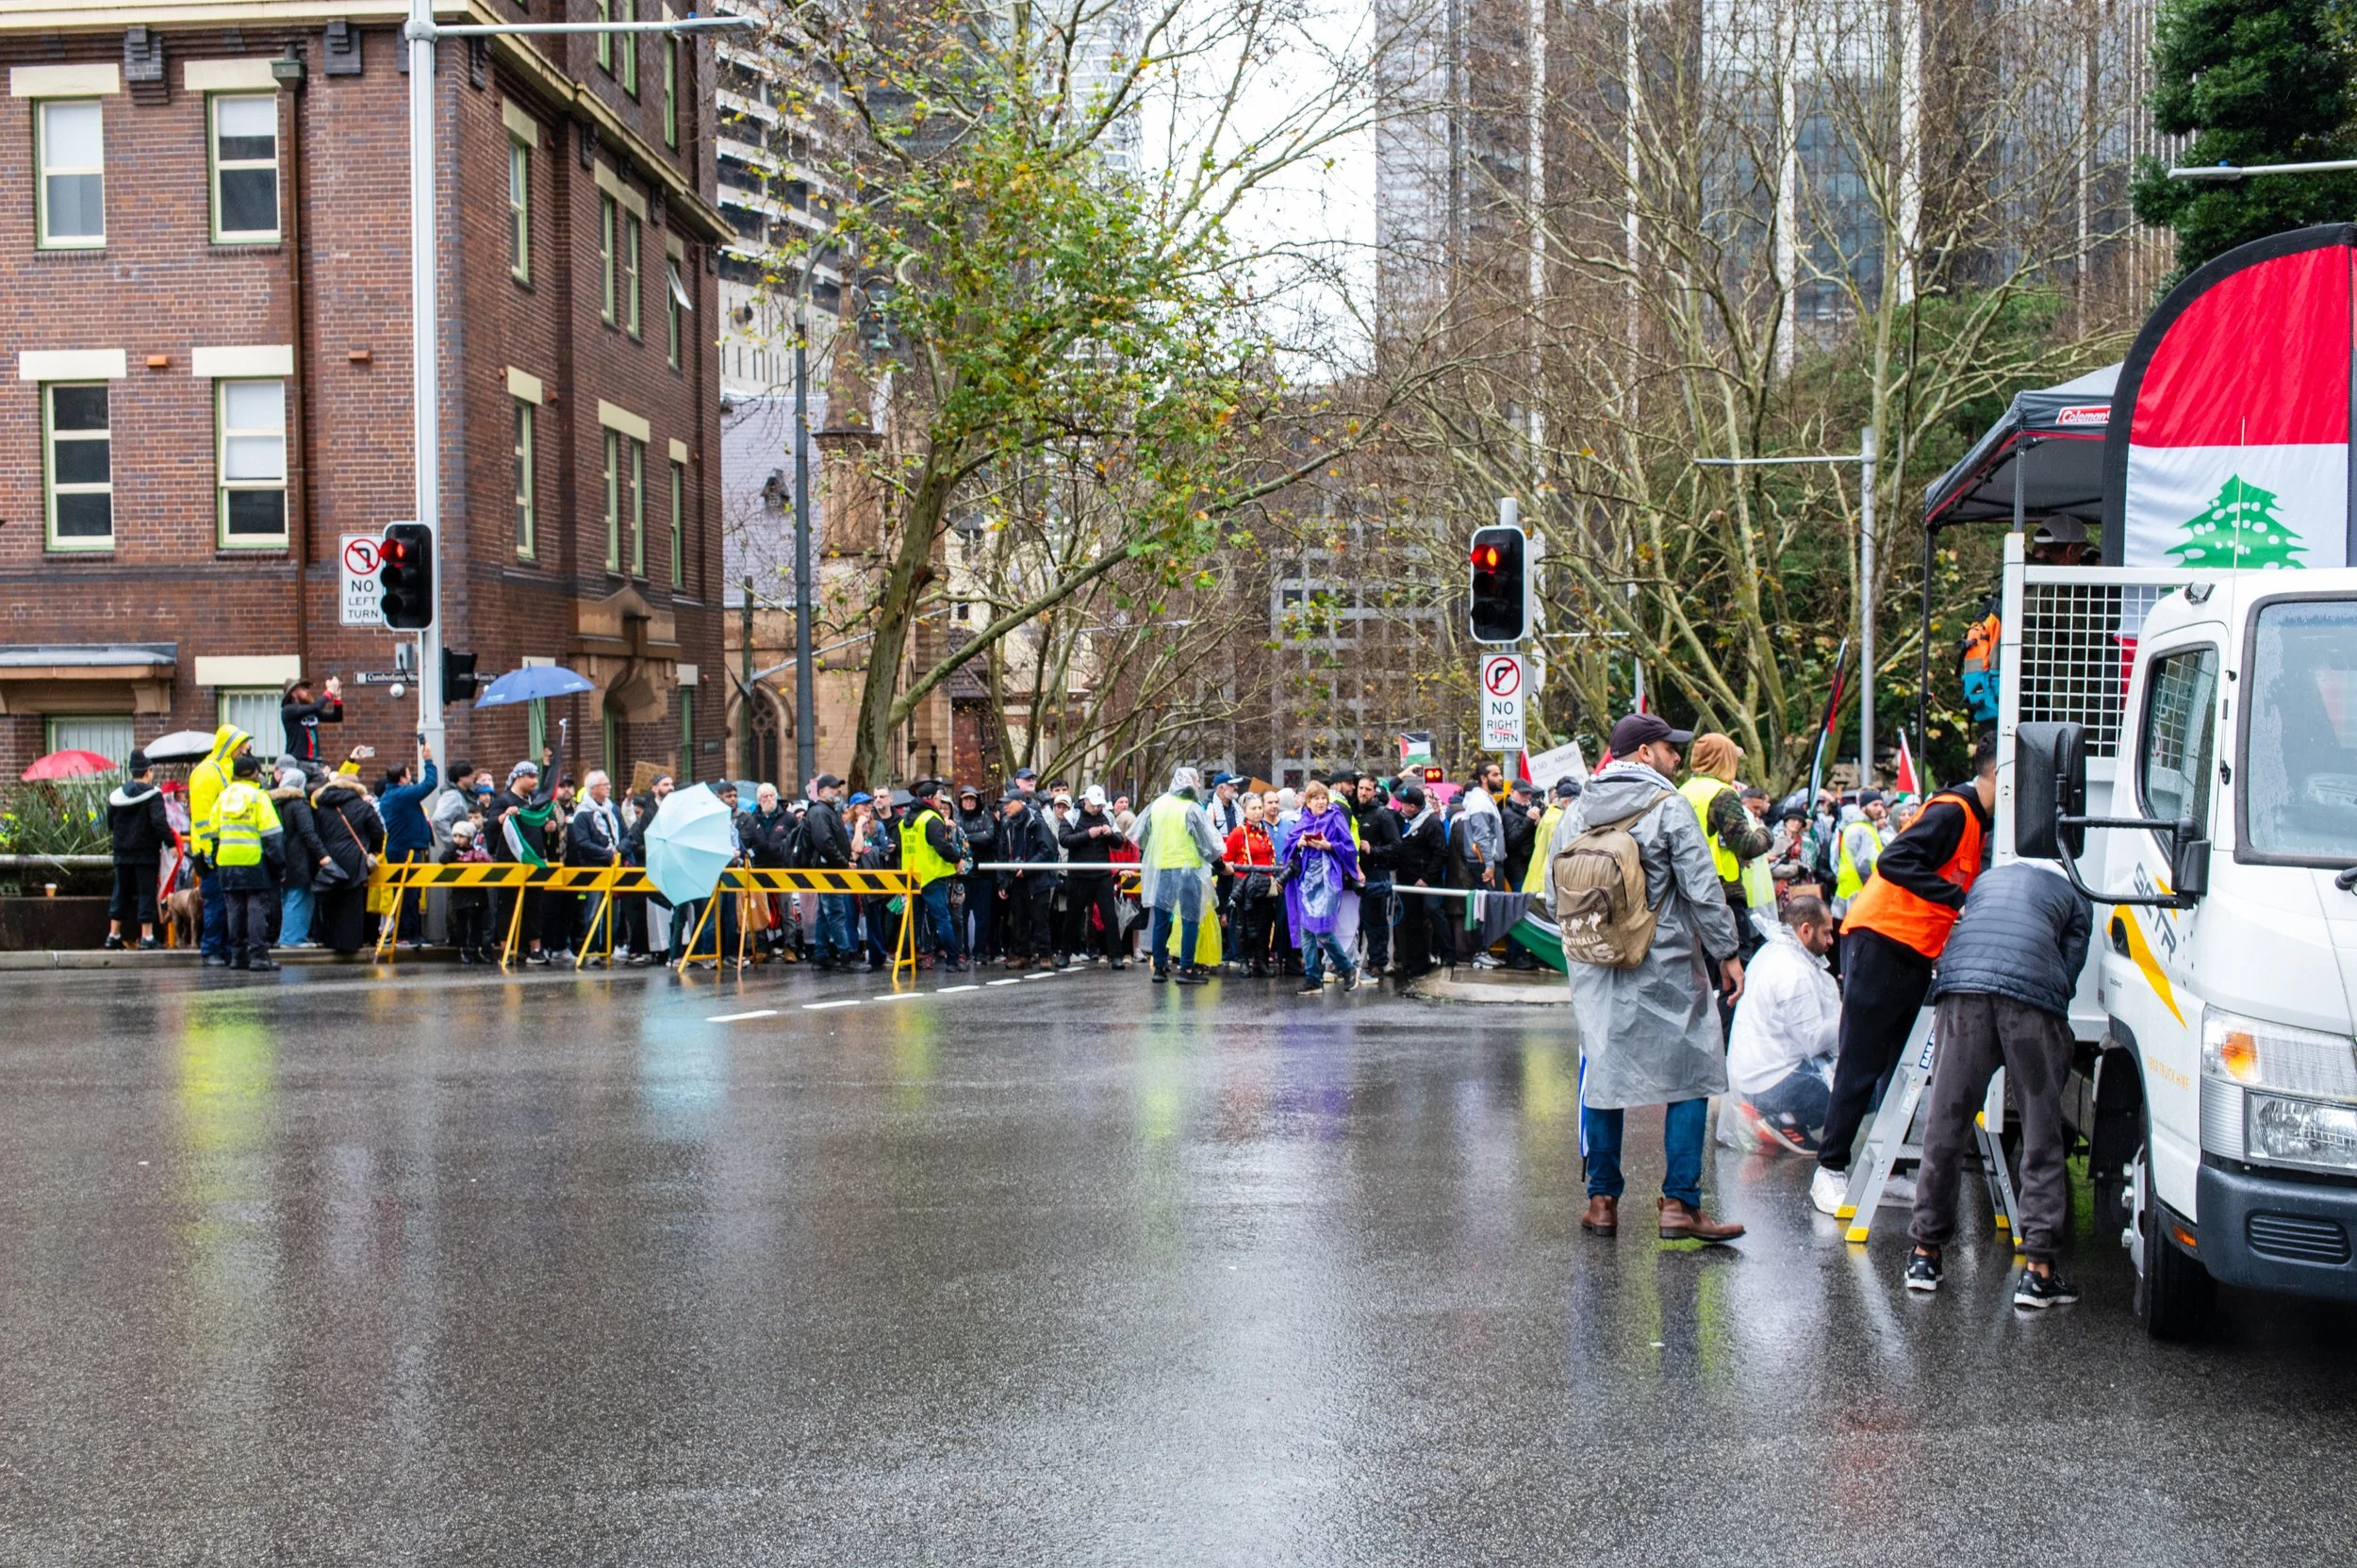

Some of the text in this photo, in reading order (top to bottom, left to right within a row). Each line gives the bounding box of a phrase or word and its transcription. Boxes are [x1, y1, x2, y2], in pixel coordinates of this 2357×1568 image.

[2062, 409, 2106, 423] Coleman
[352, 580, 373, 592] NO
[349, 597, 376, 605] LEFT
[348, 609, 378, 619] TURN
[1492, 701, 1513, 715] NO
[1487, 719, 1519, 729] RIGHT
[1490, 734, 1518, 743] TURN
[1554, 751, 1576, 764] ANGRY
[2159, 1061, 2175, 1084] TRUCK
[2176, 1073, 2189, 1091] HIRE
